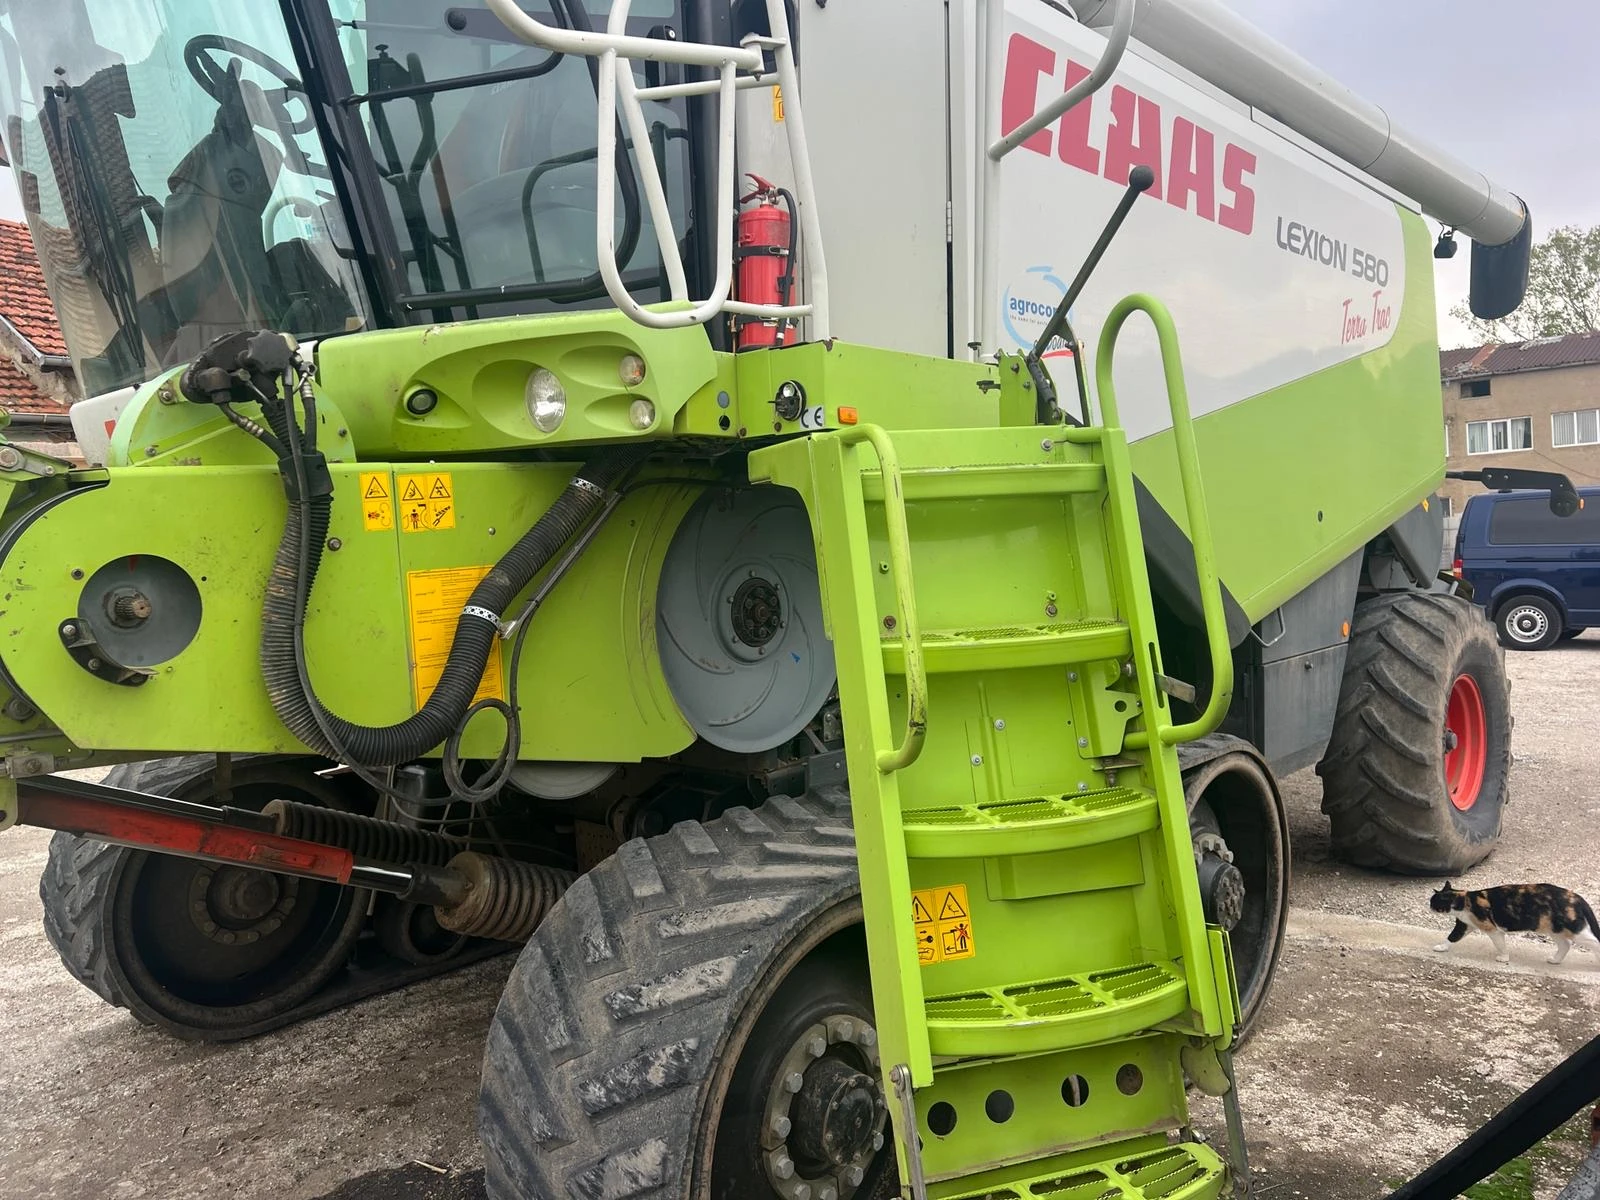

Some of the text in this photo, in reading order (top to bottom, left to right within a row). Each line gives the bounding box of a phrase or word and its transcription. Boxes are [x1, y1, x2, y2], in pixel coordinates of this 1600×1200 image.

[1001, 32, 1256, 235] CLAAS
[1277, 216, 1388, 287] LEXION 580
[1341, 290, 1391, 345] Terra Trac
[801, 407, 823, 428] CE
